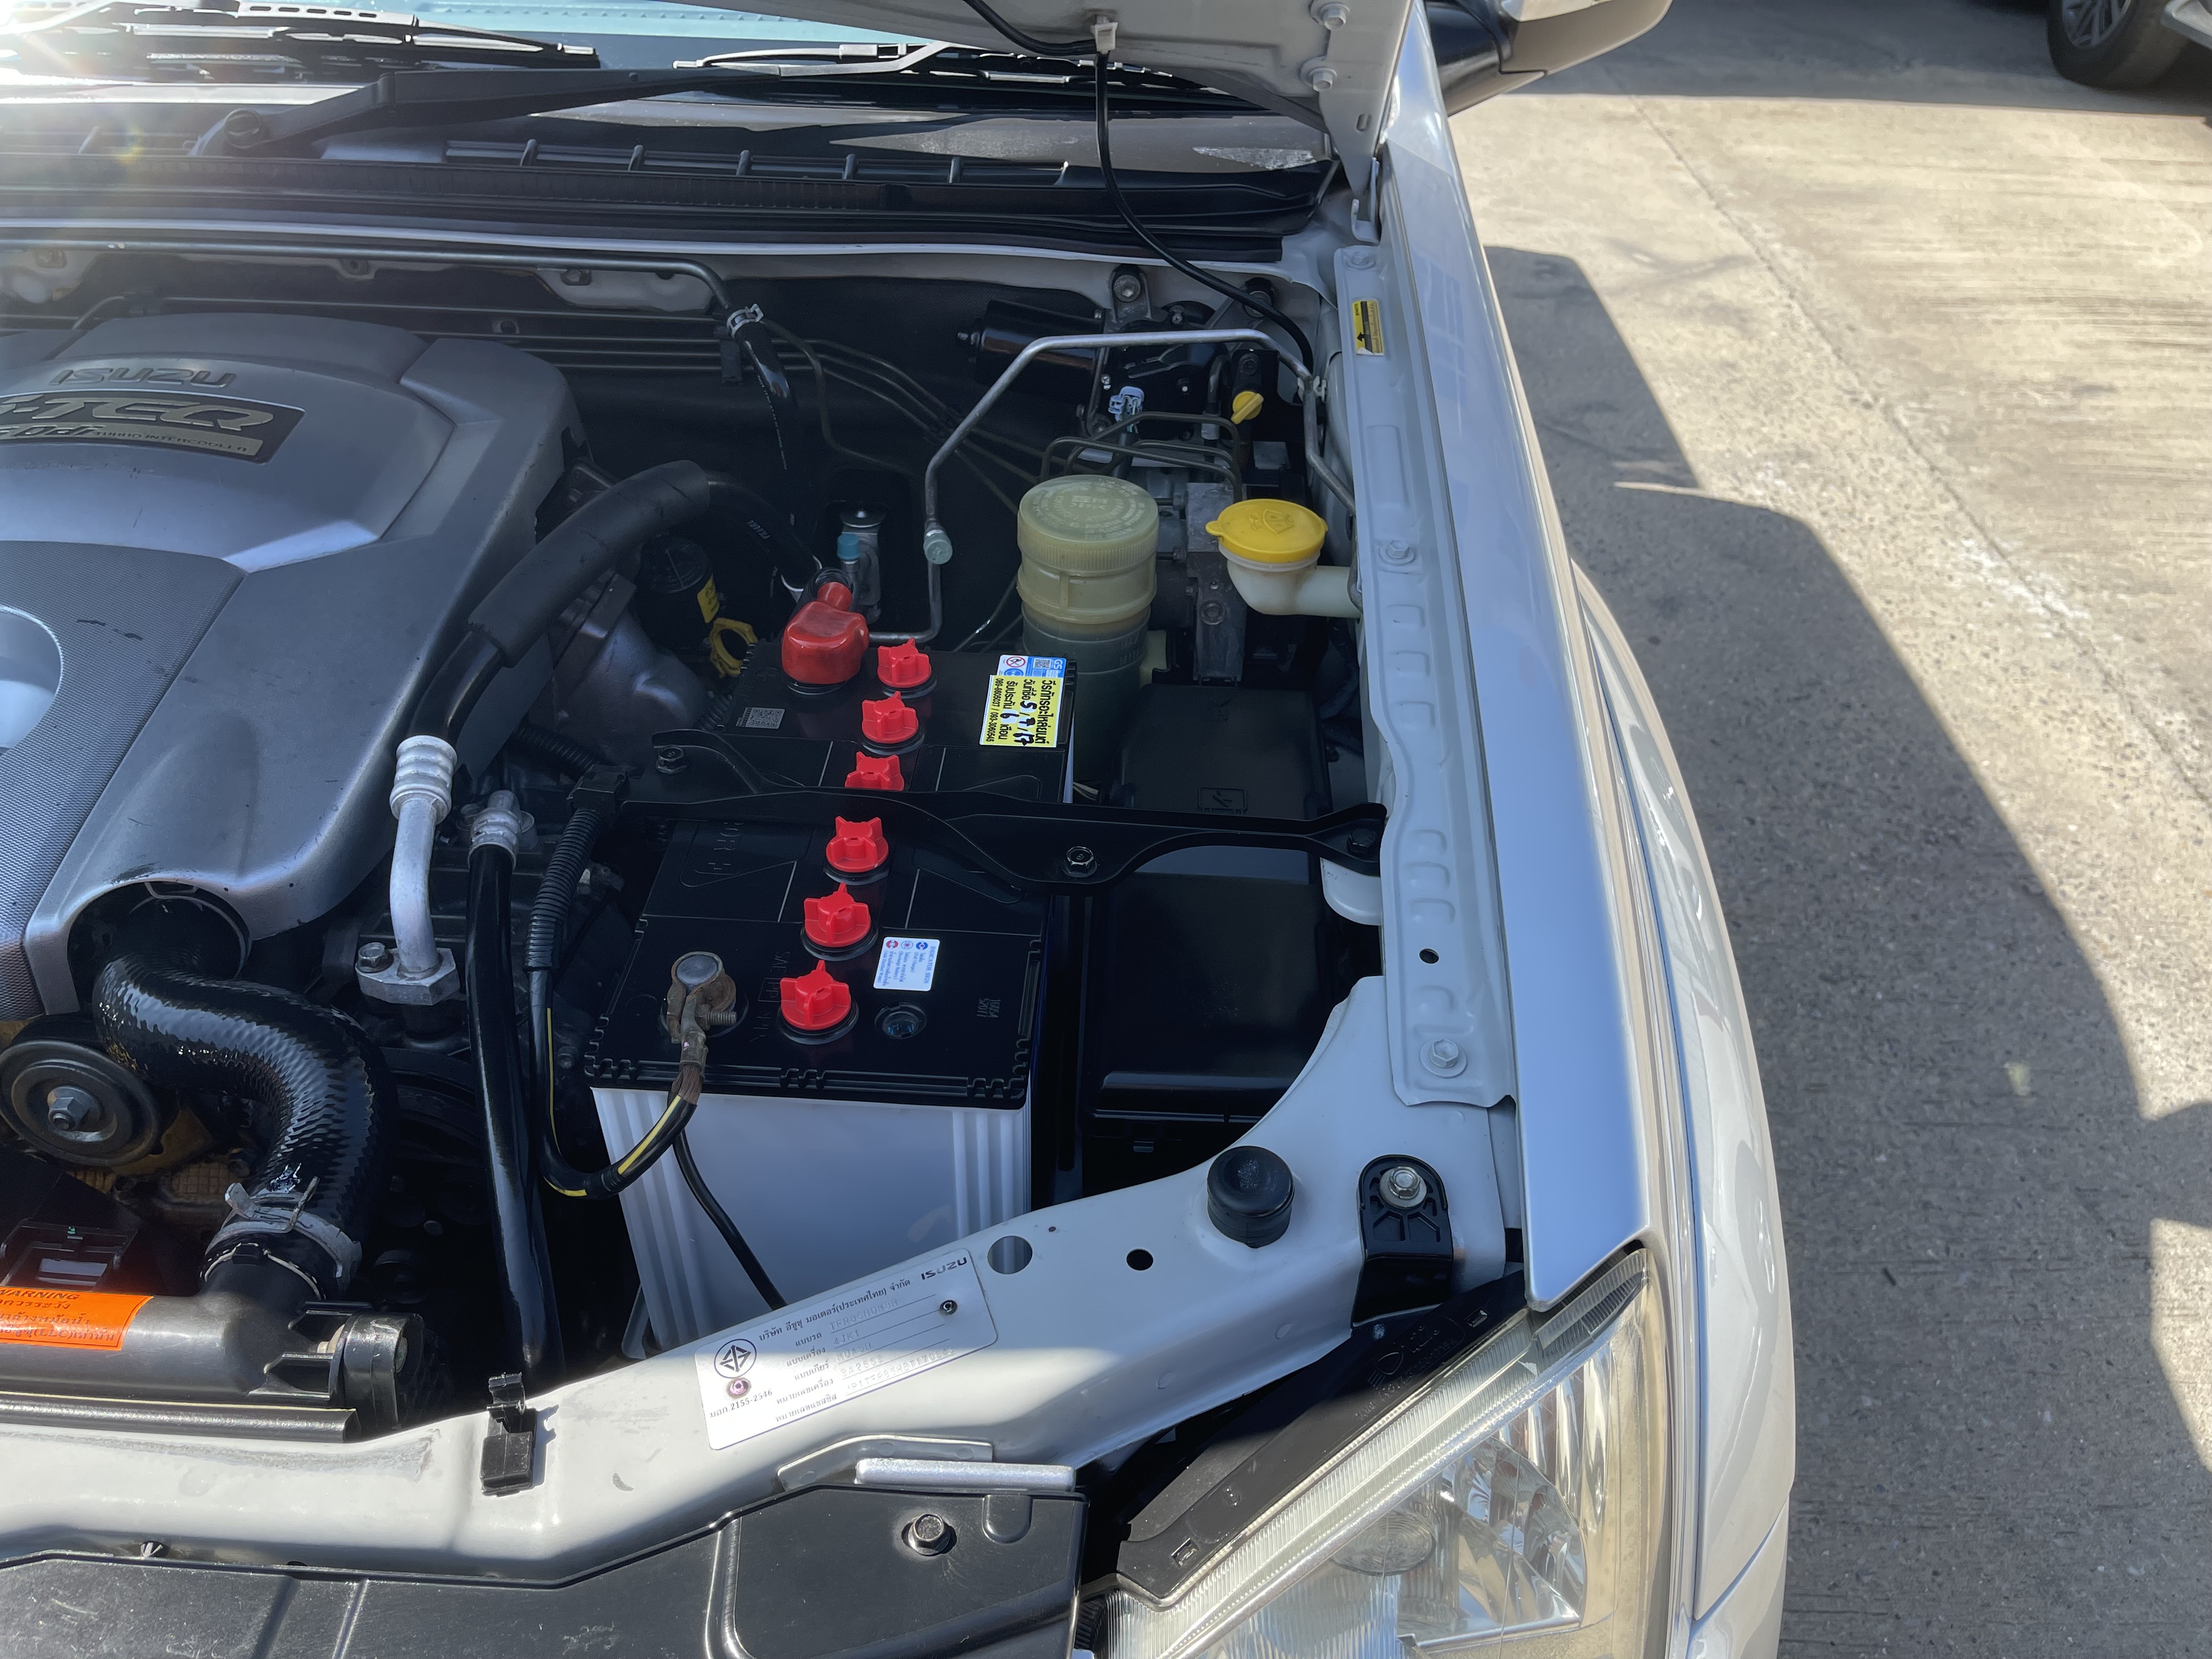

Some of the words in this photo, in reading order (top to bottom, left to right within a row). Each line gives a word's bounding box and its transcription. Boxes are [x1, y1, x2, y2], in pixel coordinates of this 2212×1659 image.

[49, 367, 237, 388] ISUZU
[1053, 659, 1063, 669] GS
[1003, 681, 1018, 709] รับประกัน
[1022, 679, 1036, 700] วันที่ซื้อ
[998, 724, 1012, 740] เดือน
[927, 946, 935, 971] INDICATOR
[921, 1256, 968, 1280] ISUZU
[759, 1326, 783, 1342] บริษัท
[806, 1288, 887, 1324] มอเตอร์(ประเทศไทย)
[889, 1278, 911, 1296] จำกัด
[795, 1331, 822, 1347] แบบรถ
[786, 1345, 826, 1368] แบบเครื่อง
[794, 1359, 830, 1380] แบบเกียร์
[776, 1376, 834, 1404] หมายเลขเครื่อง
[709, 1389, 774, 1419] มอก.2155-2546
